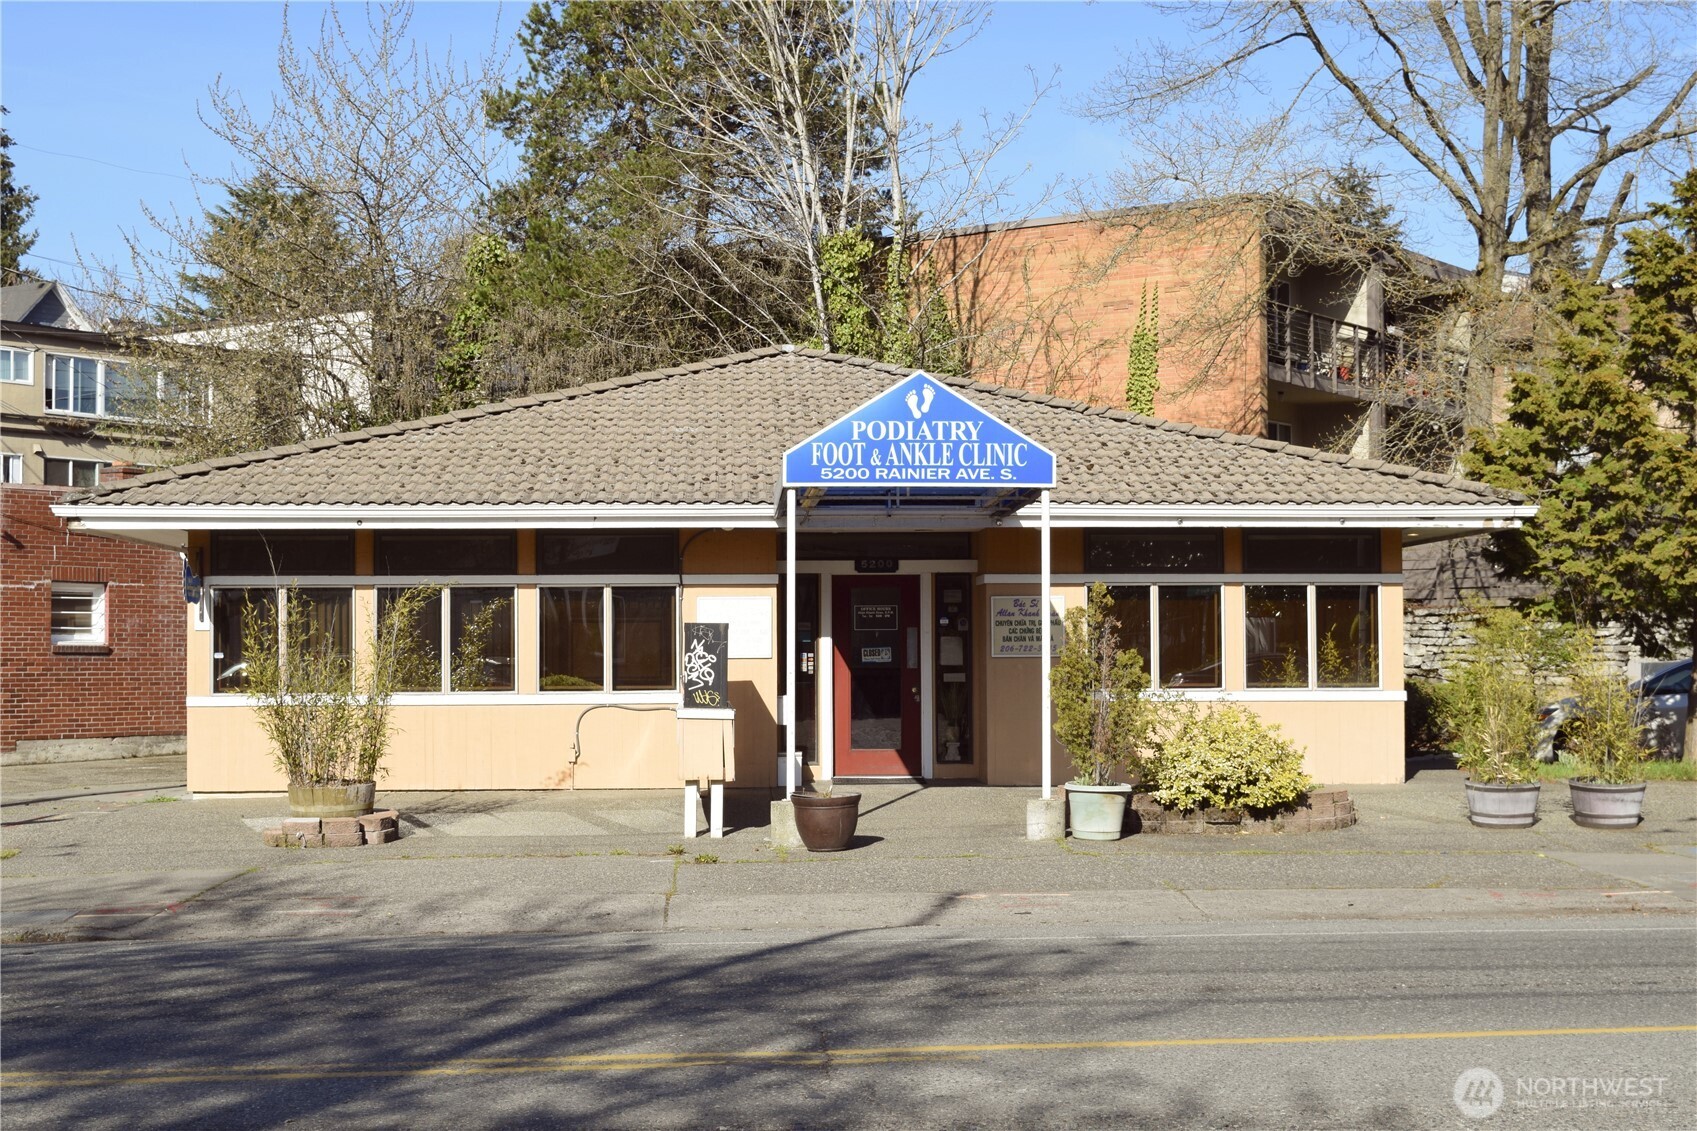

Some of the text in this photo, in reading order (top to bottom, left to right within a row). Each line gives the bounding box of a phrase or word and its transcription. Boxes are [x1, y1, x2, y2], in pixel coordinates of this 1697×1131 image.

[851, 421, 984, 441] PODIATRY
[811, 442, 1028, 466] FOOT & ANKLE CLINIC
[820, 467, 1017, 480] 5200 RAINIER AVE. S.
[861, 560, 893, 568] 5200
[995, 608, 1015, 617] Allan
[863, 648, 881, 657] CLOSED
